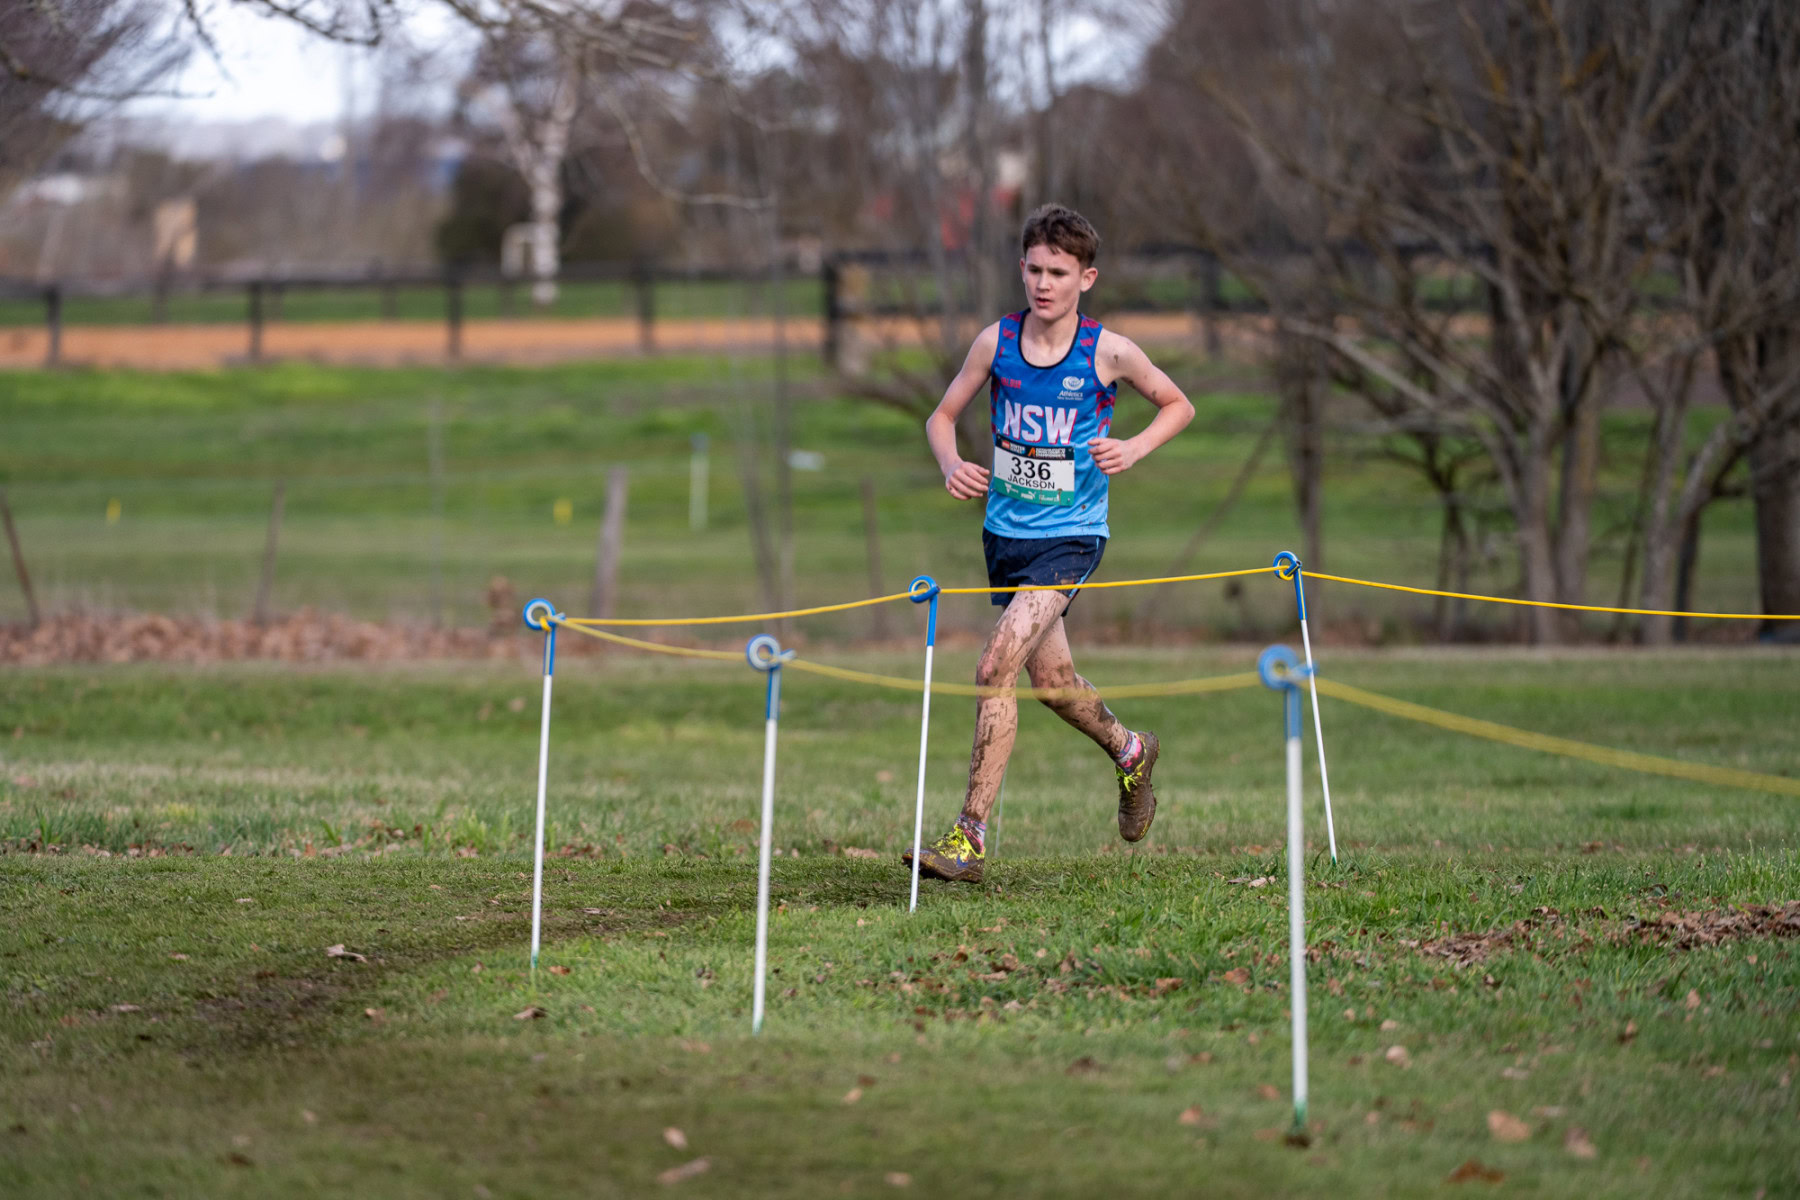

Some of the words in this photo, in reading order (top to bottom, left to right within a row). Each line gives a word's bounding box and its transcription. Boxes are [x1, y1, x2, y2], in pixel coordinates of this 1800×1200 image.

[1003, 399, 1078, 445] NSW
[1011, 456, 1051, 480] 336
[1008, 474, 1055, 489] JACKSON
